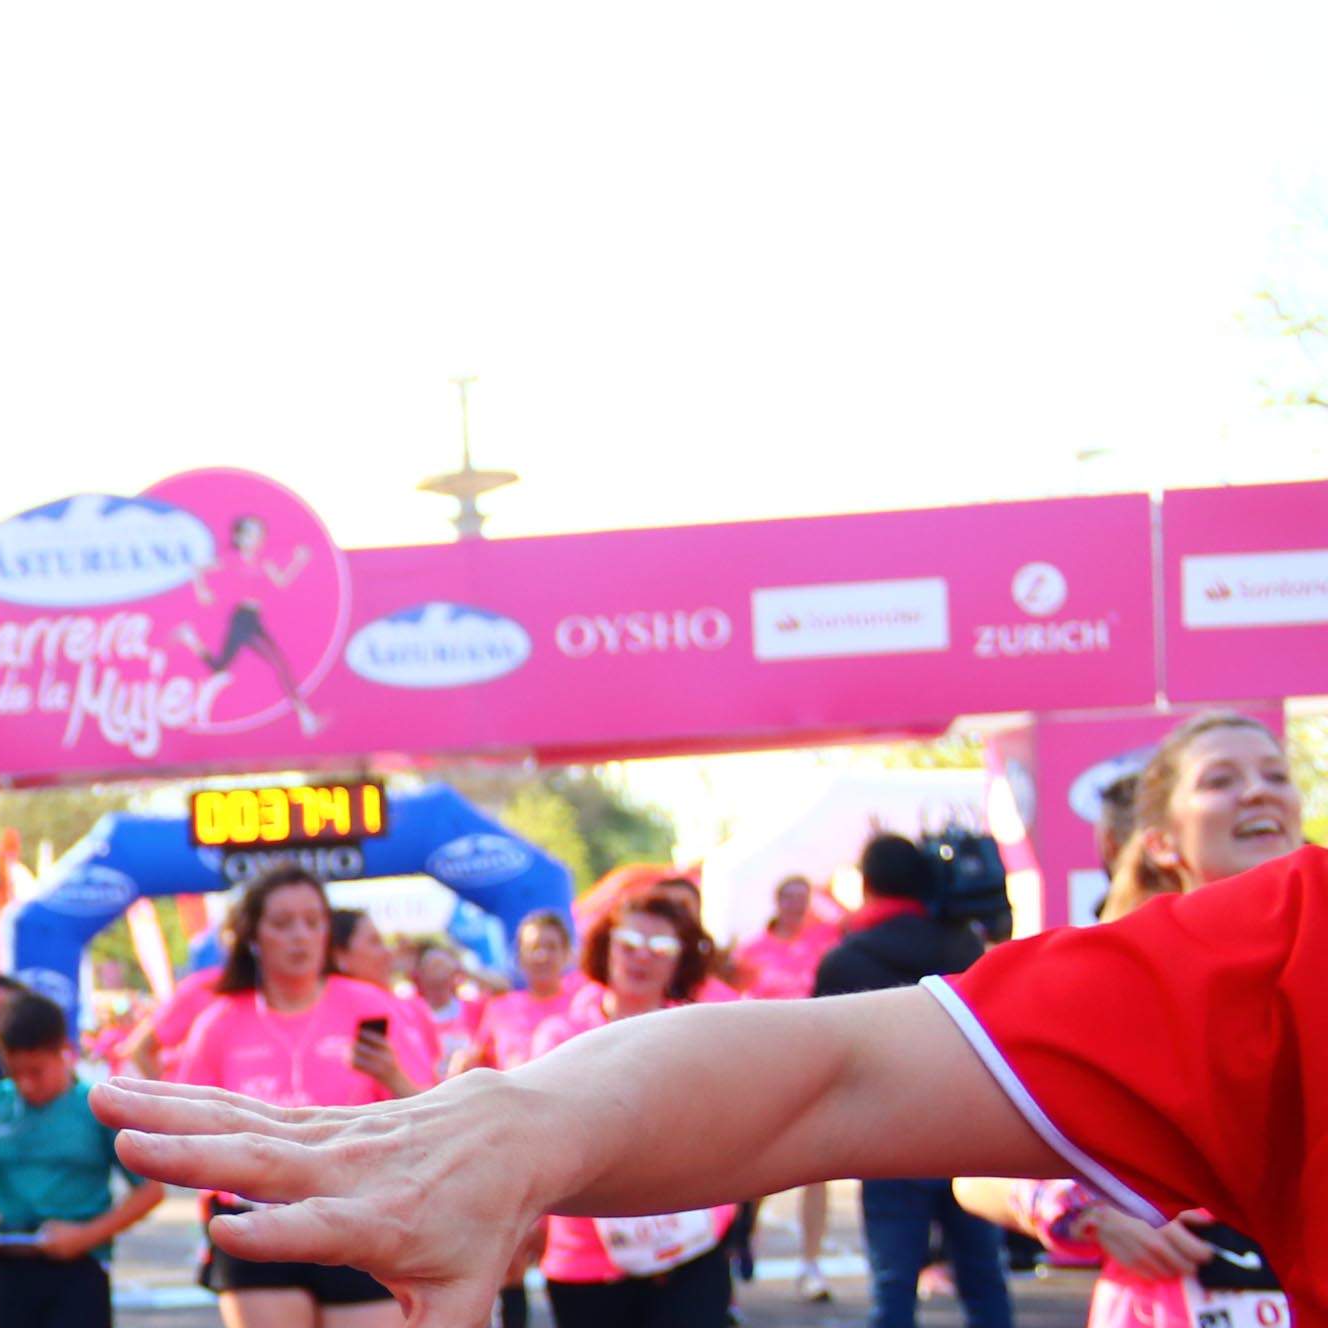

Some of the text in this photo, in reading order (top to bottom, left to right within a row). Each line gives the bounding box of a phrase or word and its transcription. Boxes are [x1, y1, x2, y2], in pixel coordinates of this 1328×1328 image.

[555, 607, 732, 659] OYSHO
[974, 620, 1109, 658] ZURICH
[37, 665, 70, 712] la
[61, 648, 233, 758] Mujer
